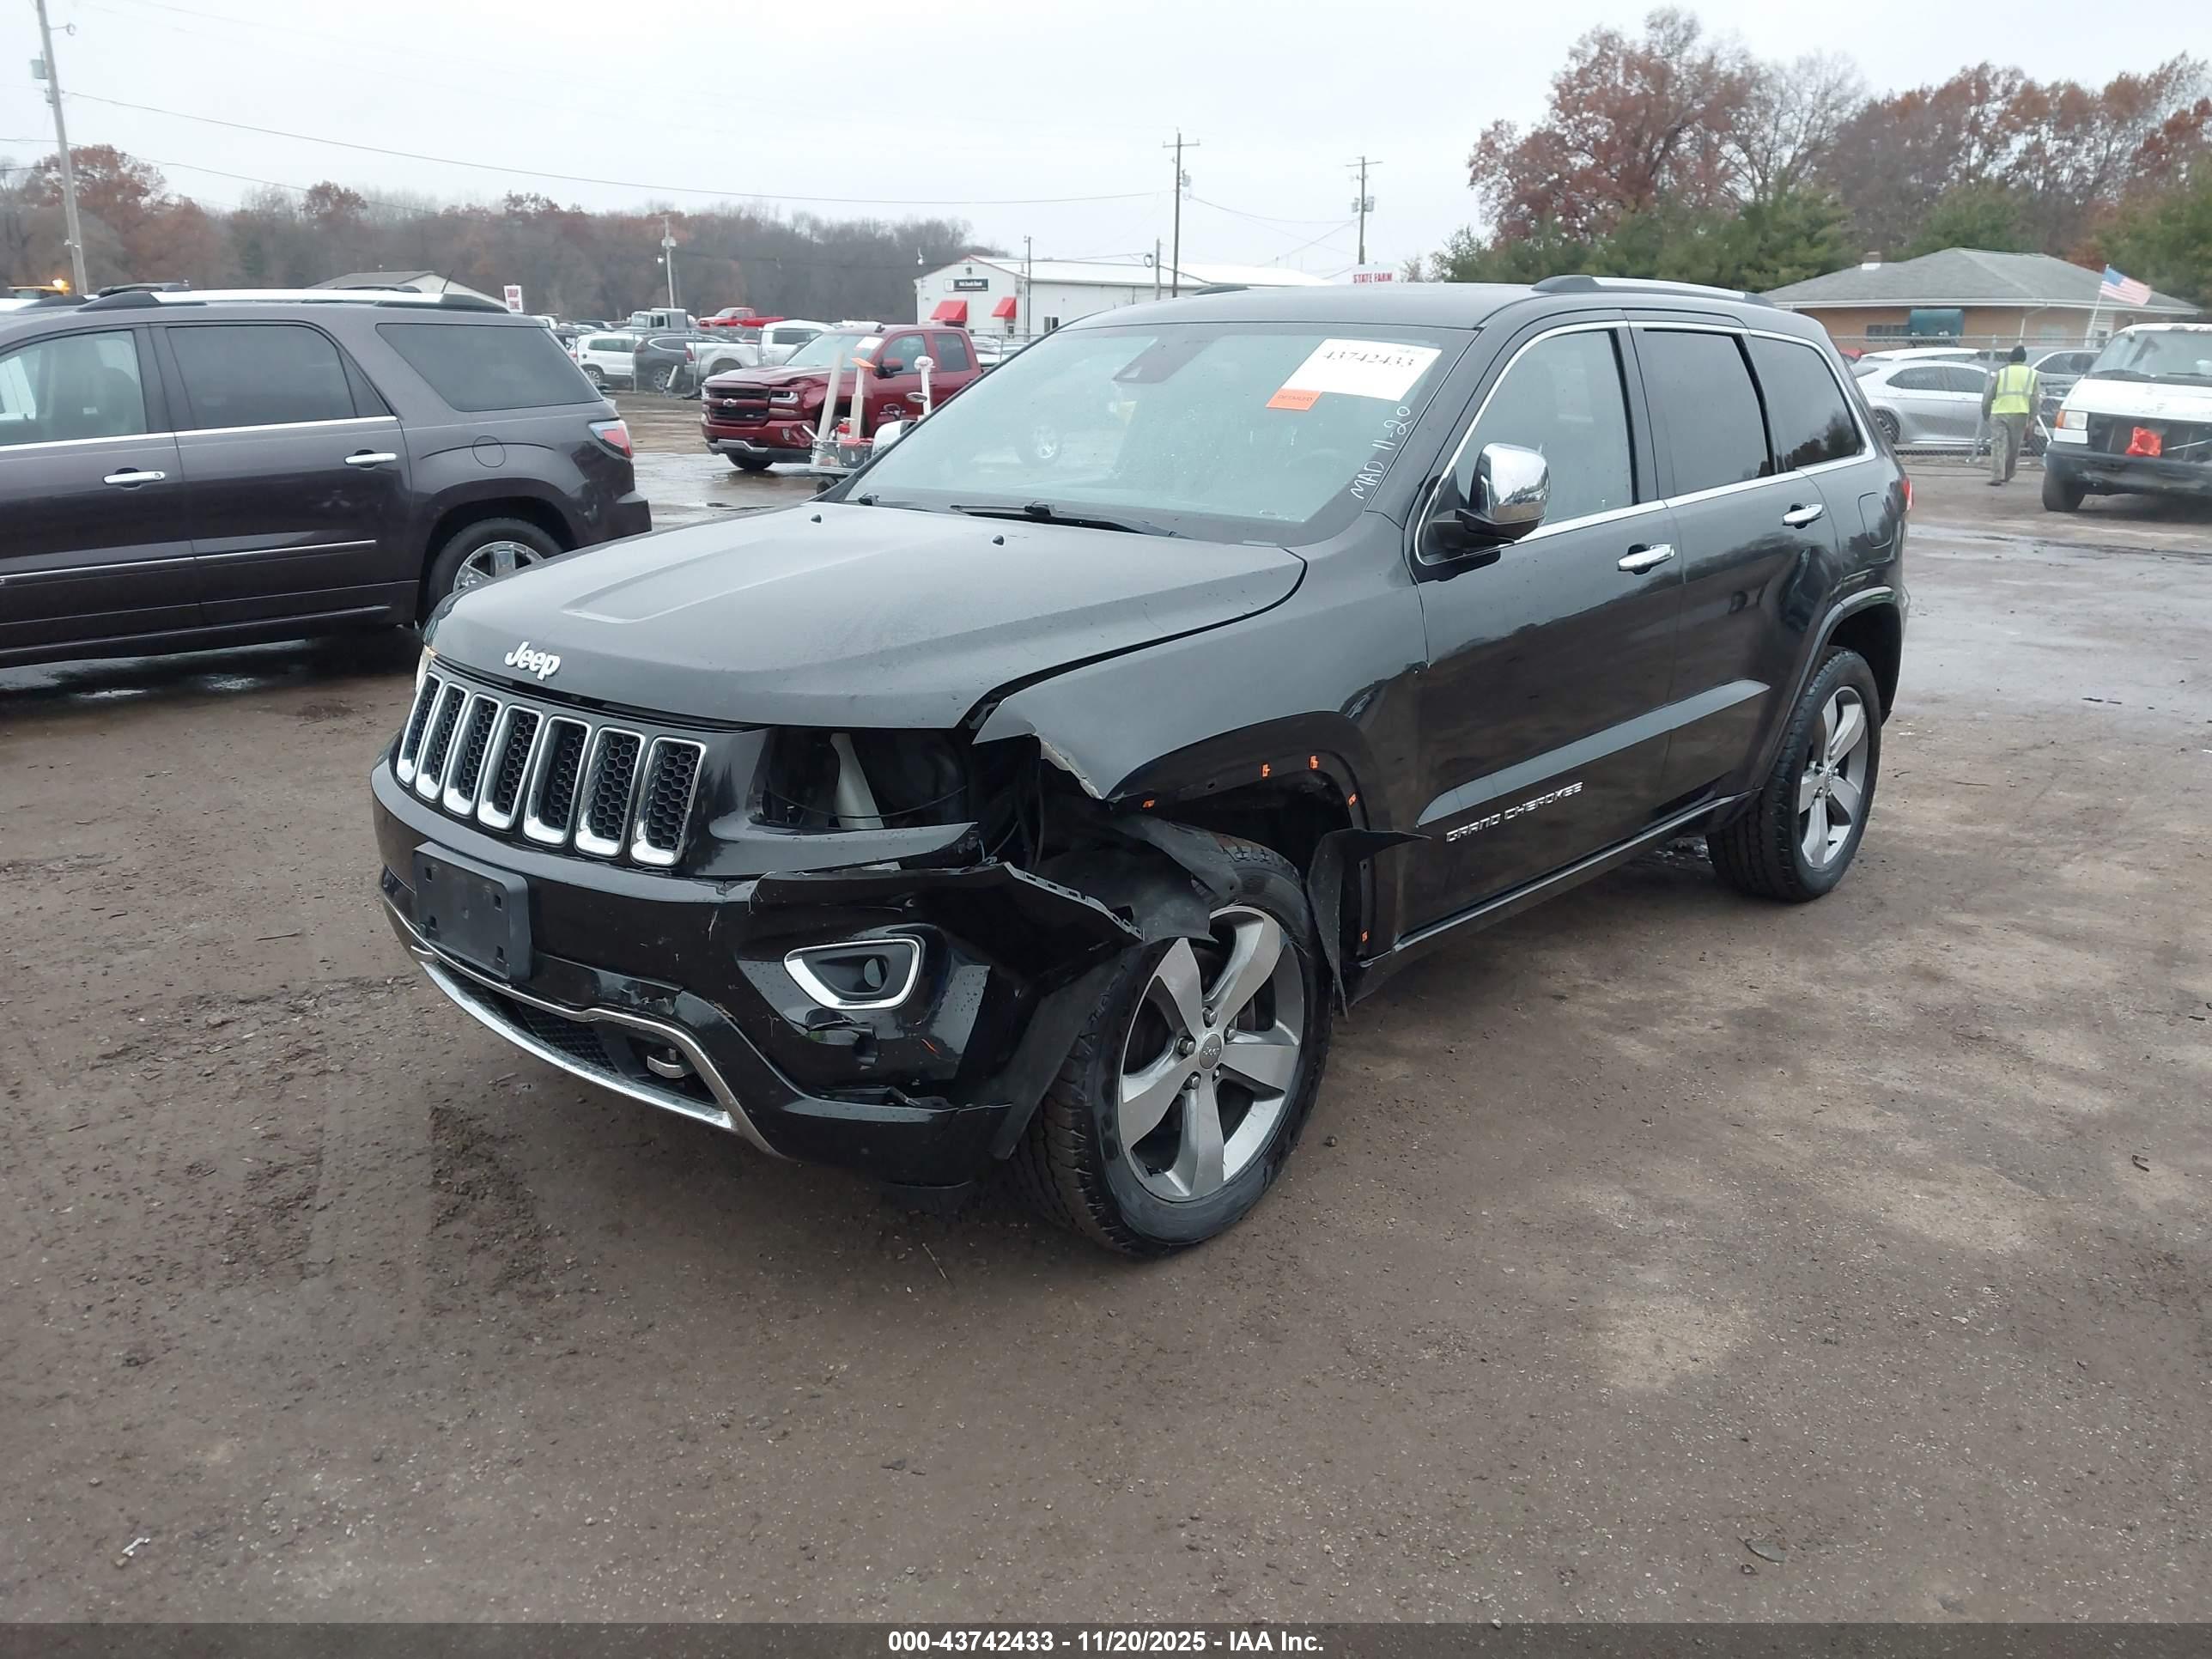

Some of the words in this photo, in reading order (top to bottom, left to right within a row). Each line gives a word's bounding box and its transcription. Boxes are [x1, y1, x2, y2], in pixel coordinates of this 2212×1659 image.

[1353, 273, 1372, 283] STATE
[1374, 272, 1393, 283] FARM
[1323, 350, 1415, 367] 43742433
[1350, 460, 1384, 500] MAD
[1371, 405, 1413, 451] 11-20
[504, 641, 561, 681] Jeep
[1446, 813, 1502, 842] GRAND
[1504, 781, 1583, 820] CHEROKEE
